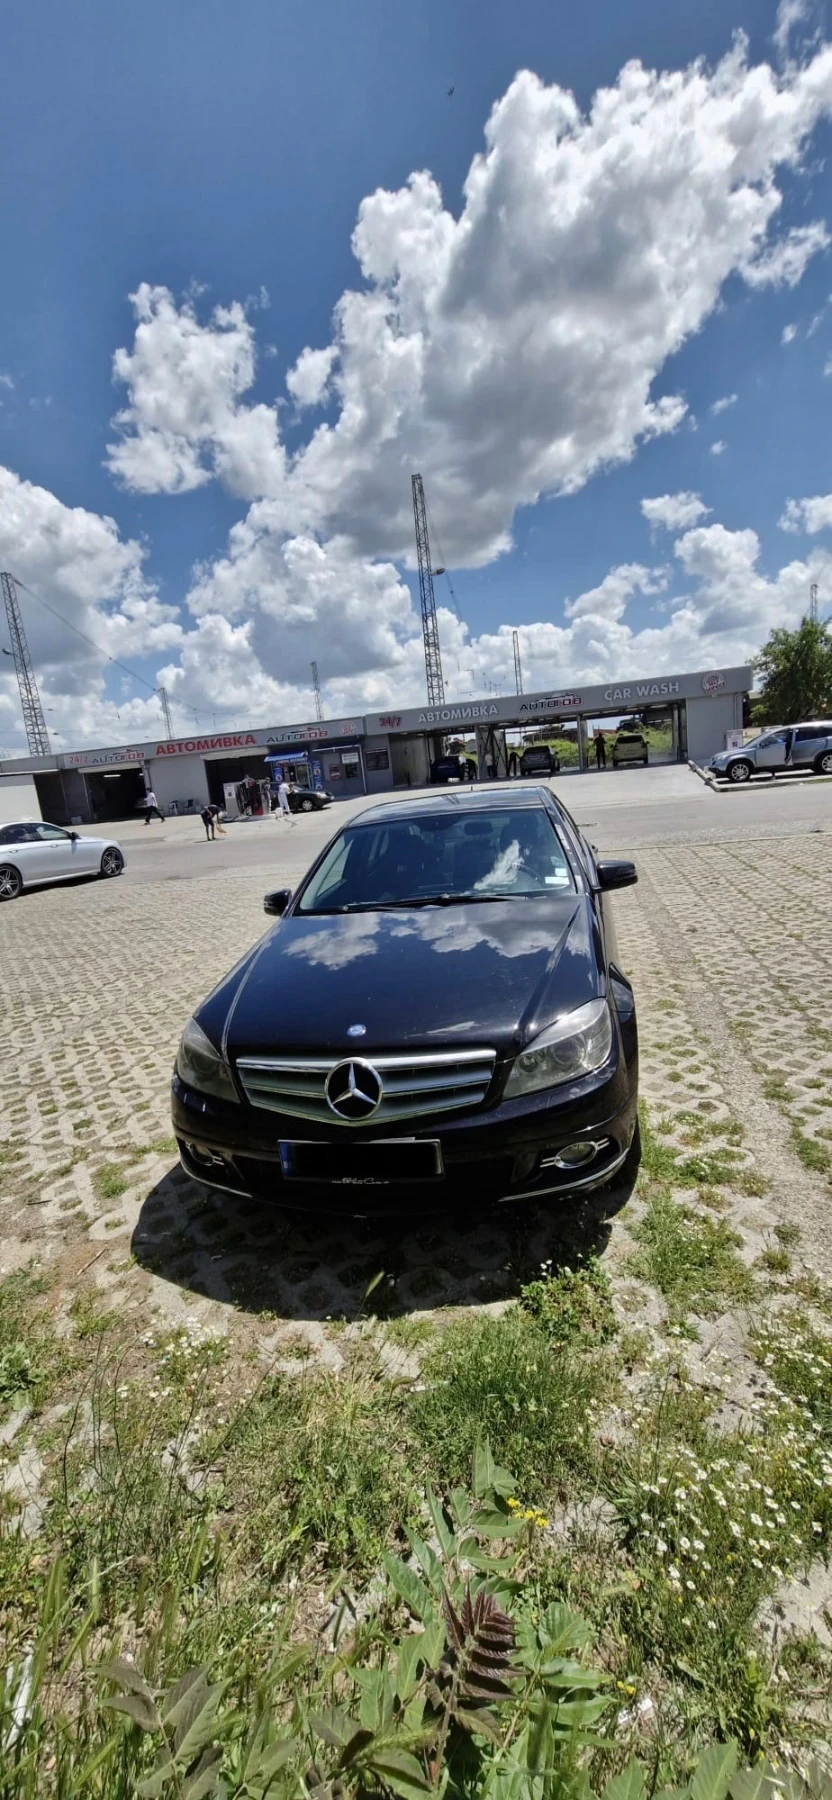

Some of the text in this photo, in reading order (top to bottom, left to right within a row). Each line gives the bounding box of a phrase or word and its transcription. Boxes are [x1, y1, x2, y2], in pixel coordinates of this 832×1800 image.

[604, 681, 680, 702] CAR WASH
[378, 715, 402, 729] 24/7
[418, 704, 498, 724] АВТОМИВКА
[155, 734, 256, 756] АВТОМИВКА
[68, 755, 90, 765] 24/7
